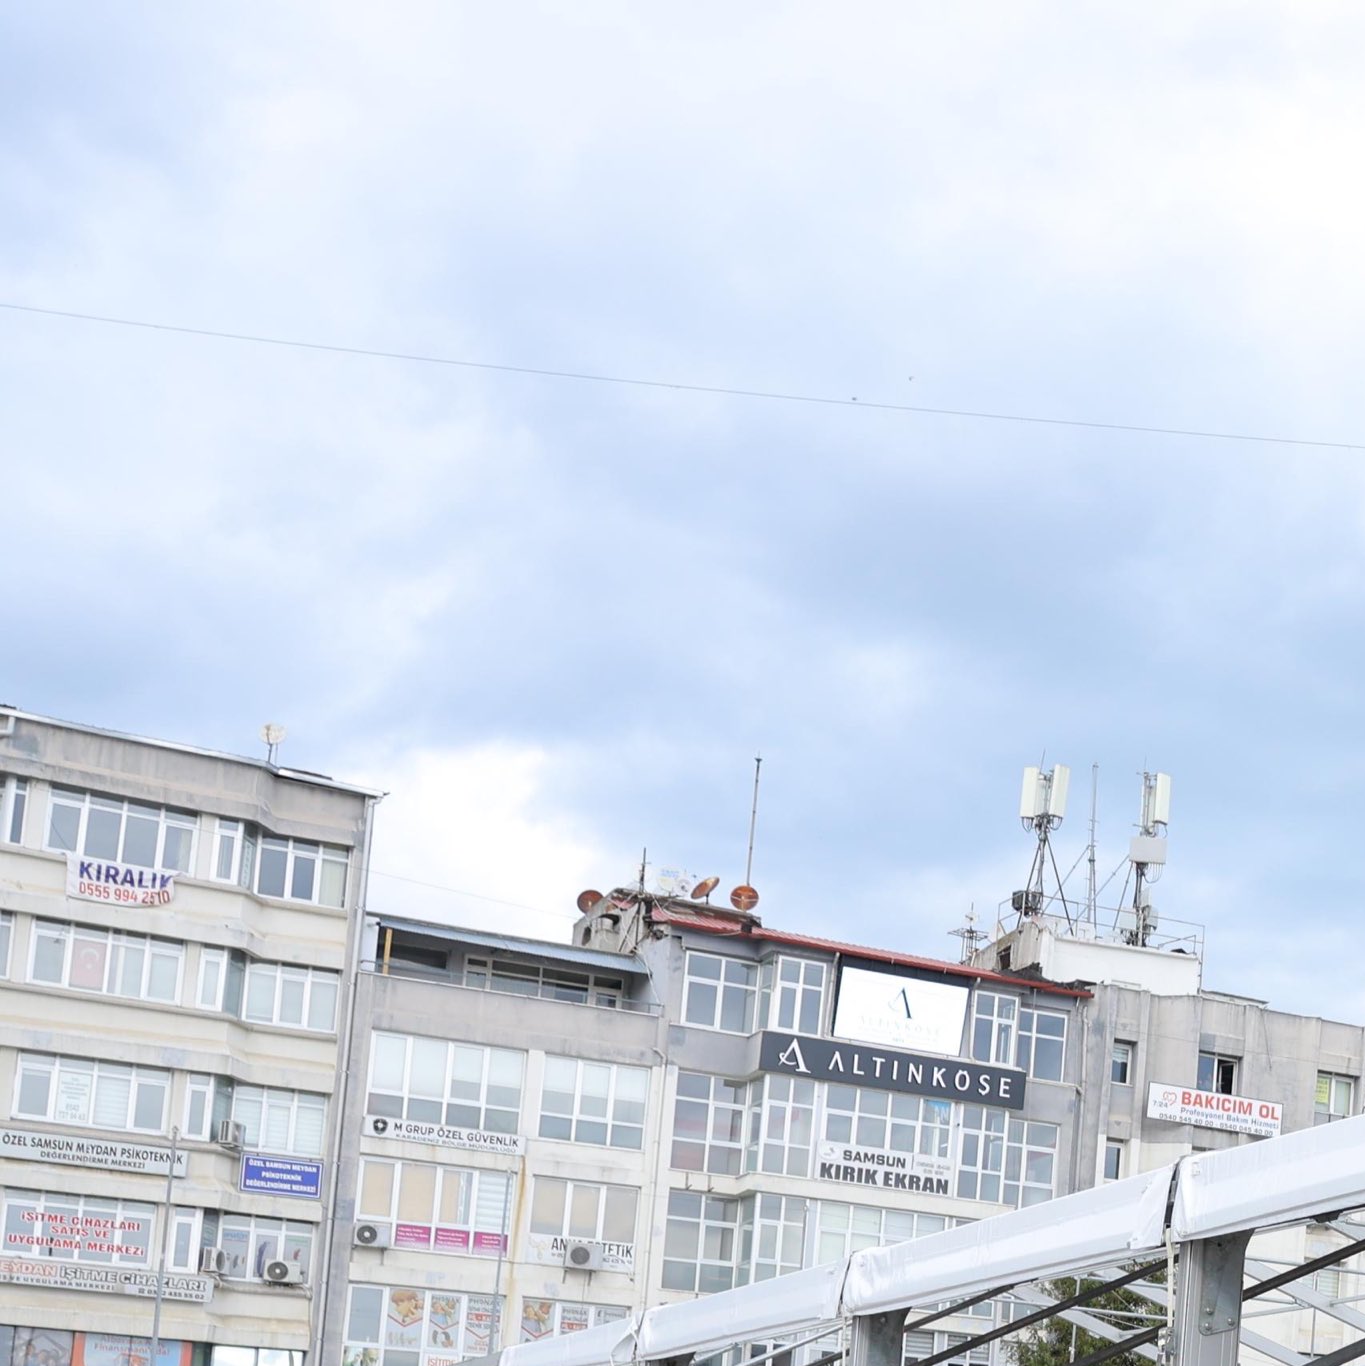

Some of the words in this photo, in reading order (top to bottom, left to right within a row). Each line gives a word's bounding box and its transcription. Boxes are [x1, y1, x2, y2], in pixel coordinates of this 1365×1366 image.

[80, 861, 172, 889] KIRALIK
[80, 882, 110, 899] 0555
[114, 888, 138, 902] 994
[828, 1050, 1012, 1097] ALTINKÖŞE
[1182, 1091, 1253, 1116] BAKICIM
[1258, 1104, 1279, 1120] OL
[1180, 1107, 1224, 1120] Profesyonel
[1251, 1119, 1279, 1129] Hizmeti
[3, 1132, 28, 1147] ÖZEL
[30, 1137, 73, 1151] SAMSUN
[76, 1143, 117, 1157] MEYDAN
[394, 1122, 402, 1131] M
[405, 1124, 434, 1136] GRUP
[437, 1127, 464, 1140] ÖZEL
[467, 1129, 519, 1147] GÜVENLİK
[40, 1151, 108, 1165] DEĞERLENDİRME
[111, 1159, 146, 1169] MERKEZİ
[266, 1161, 291, 1170] SAMSUN
[292, 1164, 317, 1173] MEYDAN
[843, 1149, 906, 1169] SAMSUN
[820, 1162, 878, 1185] KIRIK
[883, 1171, 949, 1195] EKRAN
[22, 1210, 68, 1225] İŞİTME
[71, 1216, 141, 1231] CİHAZLARI
[8, 1234, 81, 1250] UYGULAMA
[87, 1242, 144, 1256] MERKEZİ
[95, 1230, 110, 1239] VE
[23, 1277, 73, 1287] UYGULAMA
[61, 1265, 118, 1283] İŞİTME
[119, 1273, 207, 1293] CİHAZLARI
